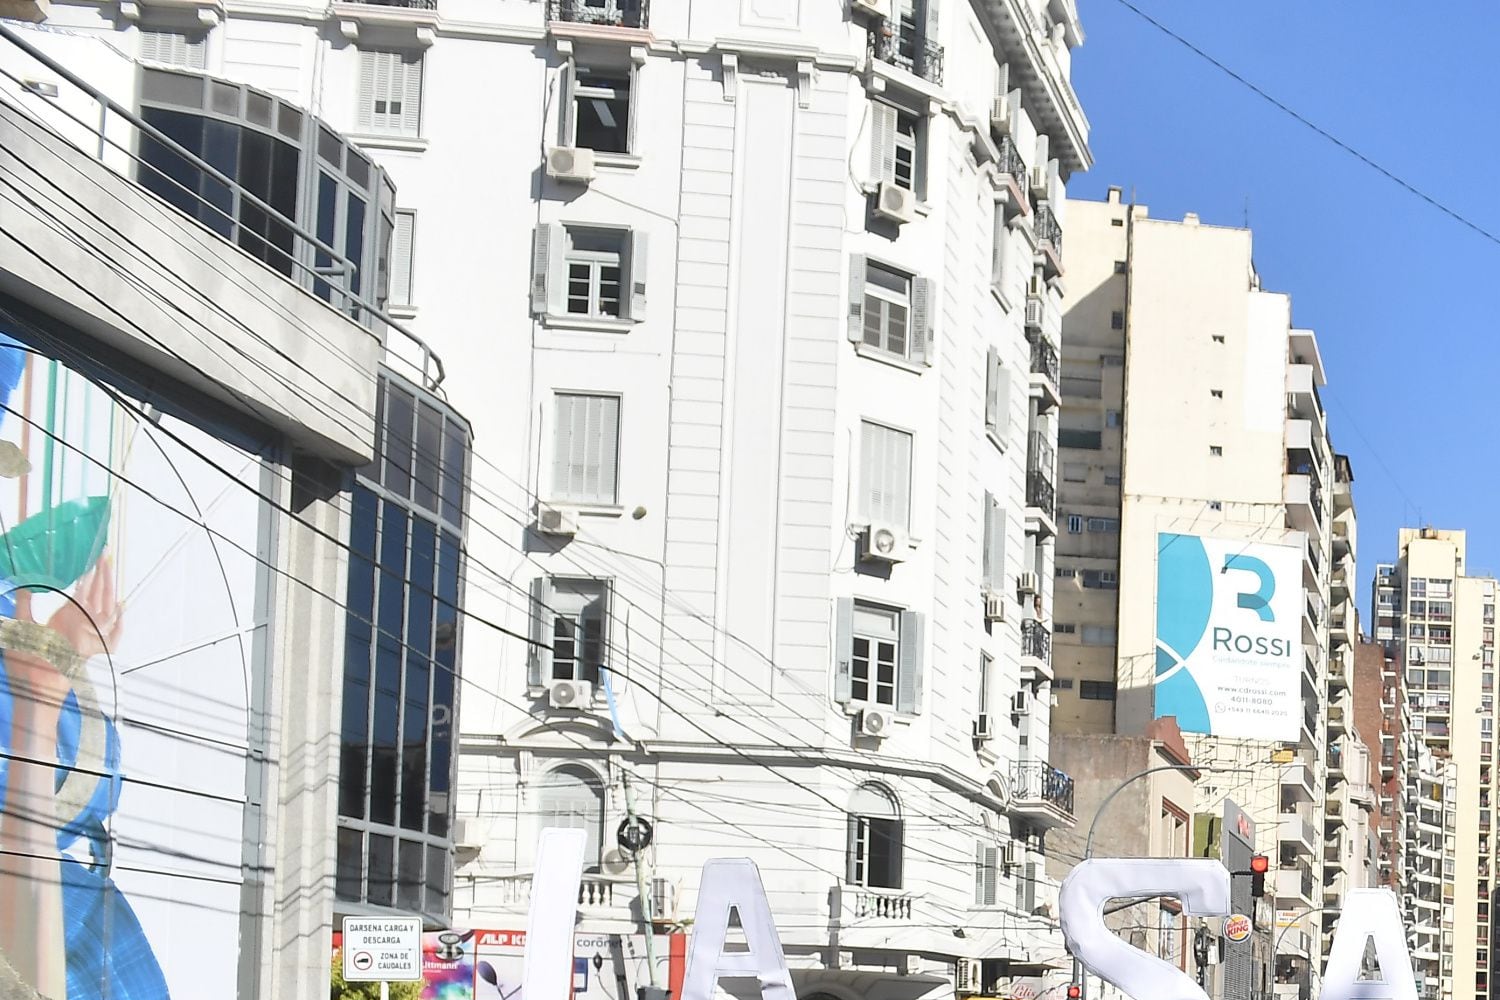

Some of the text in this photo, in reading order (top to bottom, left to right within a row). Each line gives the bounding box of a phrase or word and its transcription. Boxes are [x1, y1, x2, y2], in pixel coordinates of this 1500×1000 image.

[349, 924, 382, 932] DARSENA
[384, 924, 409, 932] CARGA
[1227, 925, 1249, 937] KING
[362, 936, 401, 944] DESCARGA
[380, 952, 409, 960] ZONA DE
